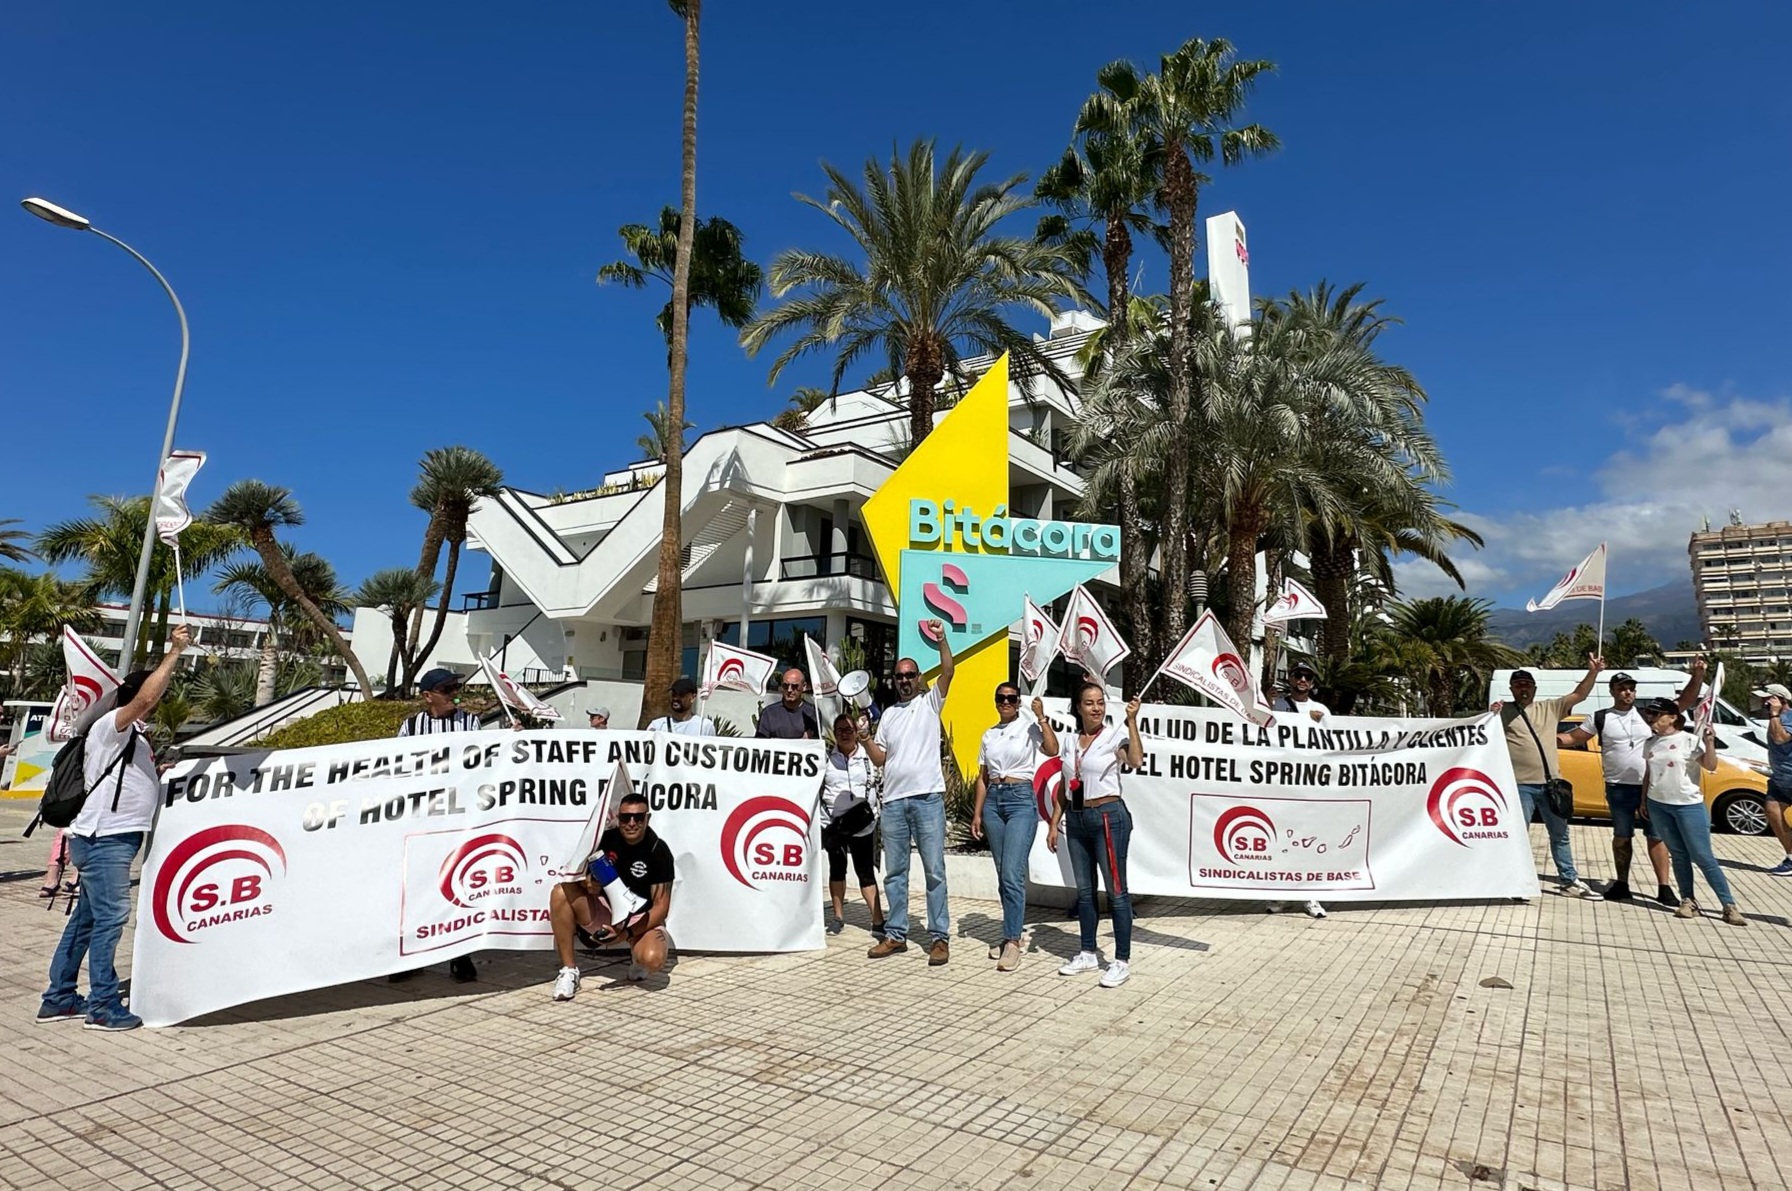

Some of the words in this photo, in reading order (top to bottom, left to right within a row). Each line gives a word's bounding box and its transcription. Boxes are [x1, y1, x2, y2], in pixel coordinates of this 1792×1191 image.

[909, 498, 1120, 559] Bitácora
[1173, 662, 1230, 701] SINDICALISTAS
[1138, 717, 1196, 740] ALUD
[1205, 720, 1234, 744] DE
[1242, 723, 1271, 747] LA
[1279, 724, 1391, 751] PLANTILLA
[1393, 731, 1408, 749] Y
[1407, 723, 1488, 749] CLIENTES
[165, 770, 237, 808] FOR
[250, 761, 316, 794] THE
[327, 746, 450, 785] HEALTH
[463, 743, 501, 770] OF
[512, 739, 597, 764] STAFF
[607, 740, 656, 765] AND
[665, 740, 820, 778] CUSTOMERS
[1171, 754, 1242, 783] HOTEL
[1249, 761, 1331, 786] SPRING
[1338, 756, 1427, 787] BITÁCORA
[302, 801, 346, 832] OF
[359, 786, 466, 825] HOTEL
[476, 777, 587, 811] SPRING
[598, 773, 718, 811] ÁCORA
[1460, 806, 1499, 827] S.B
[1234, 836, 1267, 852] S.B
[1462, 830, 1509, 840] CANARIAS
[754, 842, 803, 867] S.B
[1233, 853, 1272, 861] CANARIAS
[751, 870, 809, 883] CANARIAS
[1199, 867, 1302, 882] SINDICALISTAS
[1306, 870, 1324, 882] DE
[1326, 871, 1362, 882] BASE
[190, 874, 262, 914] S.B
[186, 904, 273, 933] CANARIAS
[416, 907, 551, 940] SINDICALISTA
